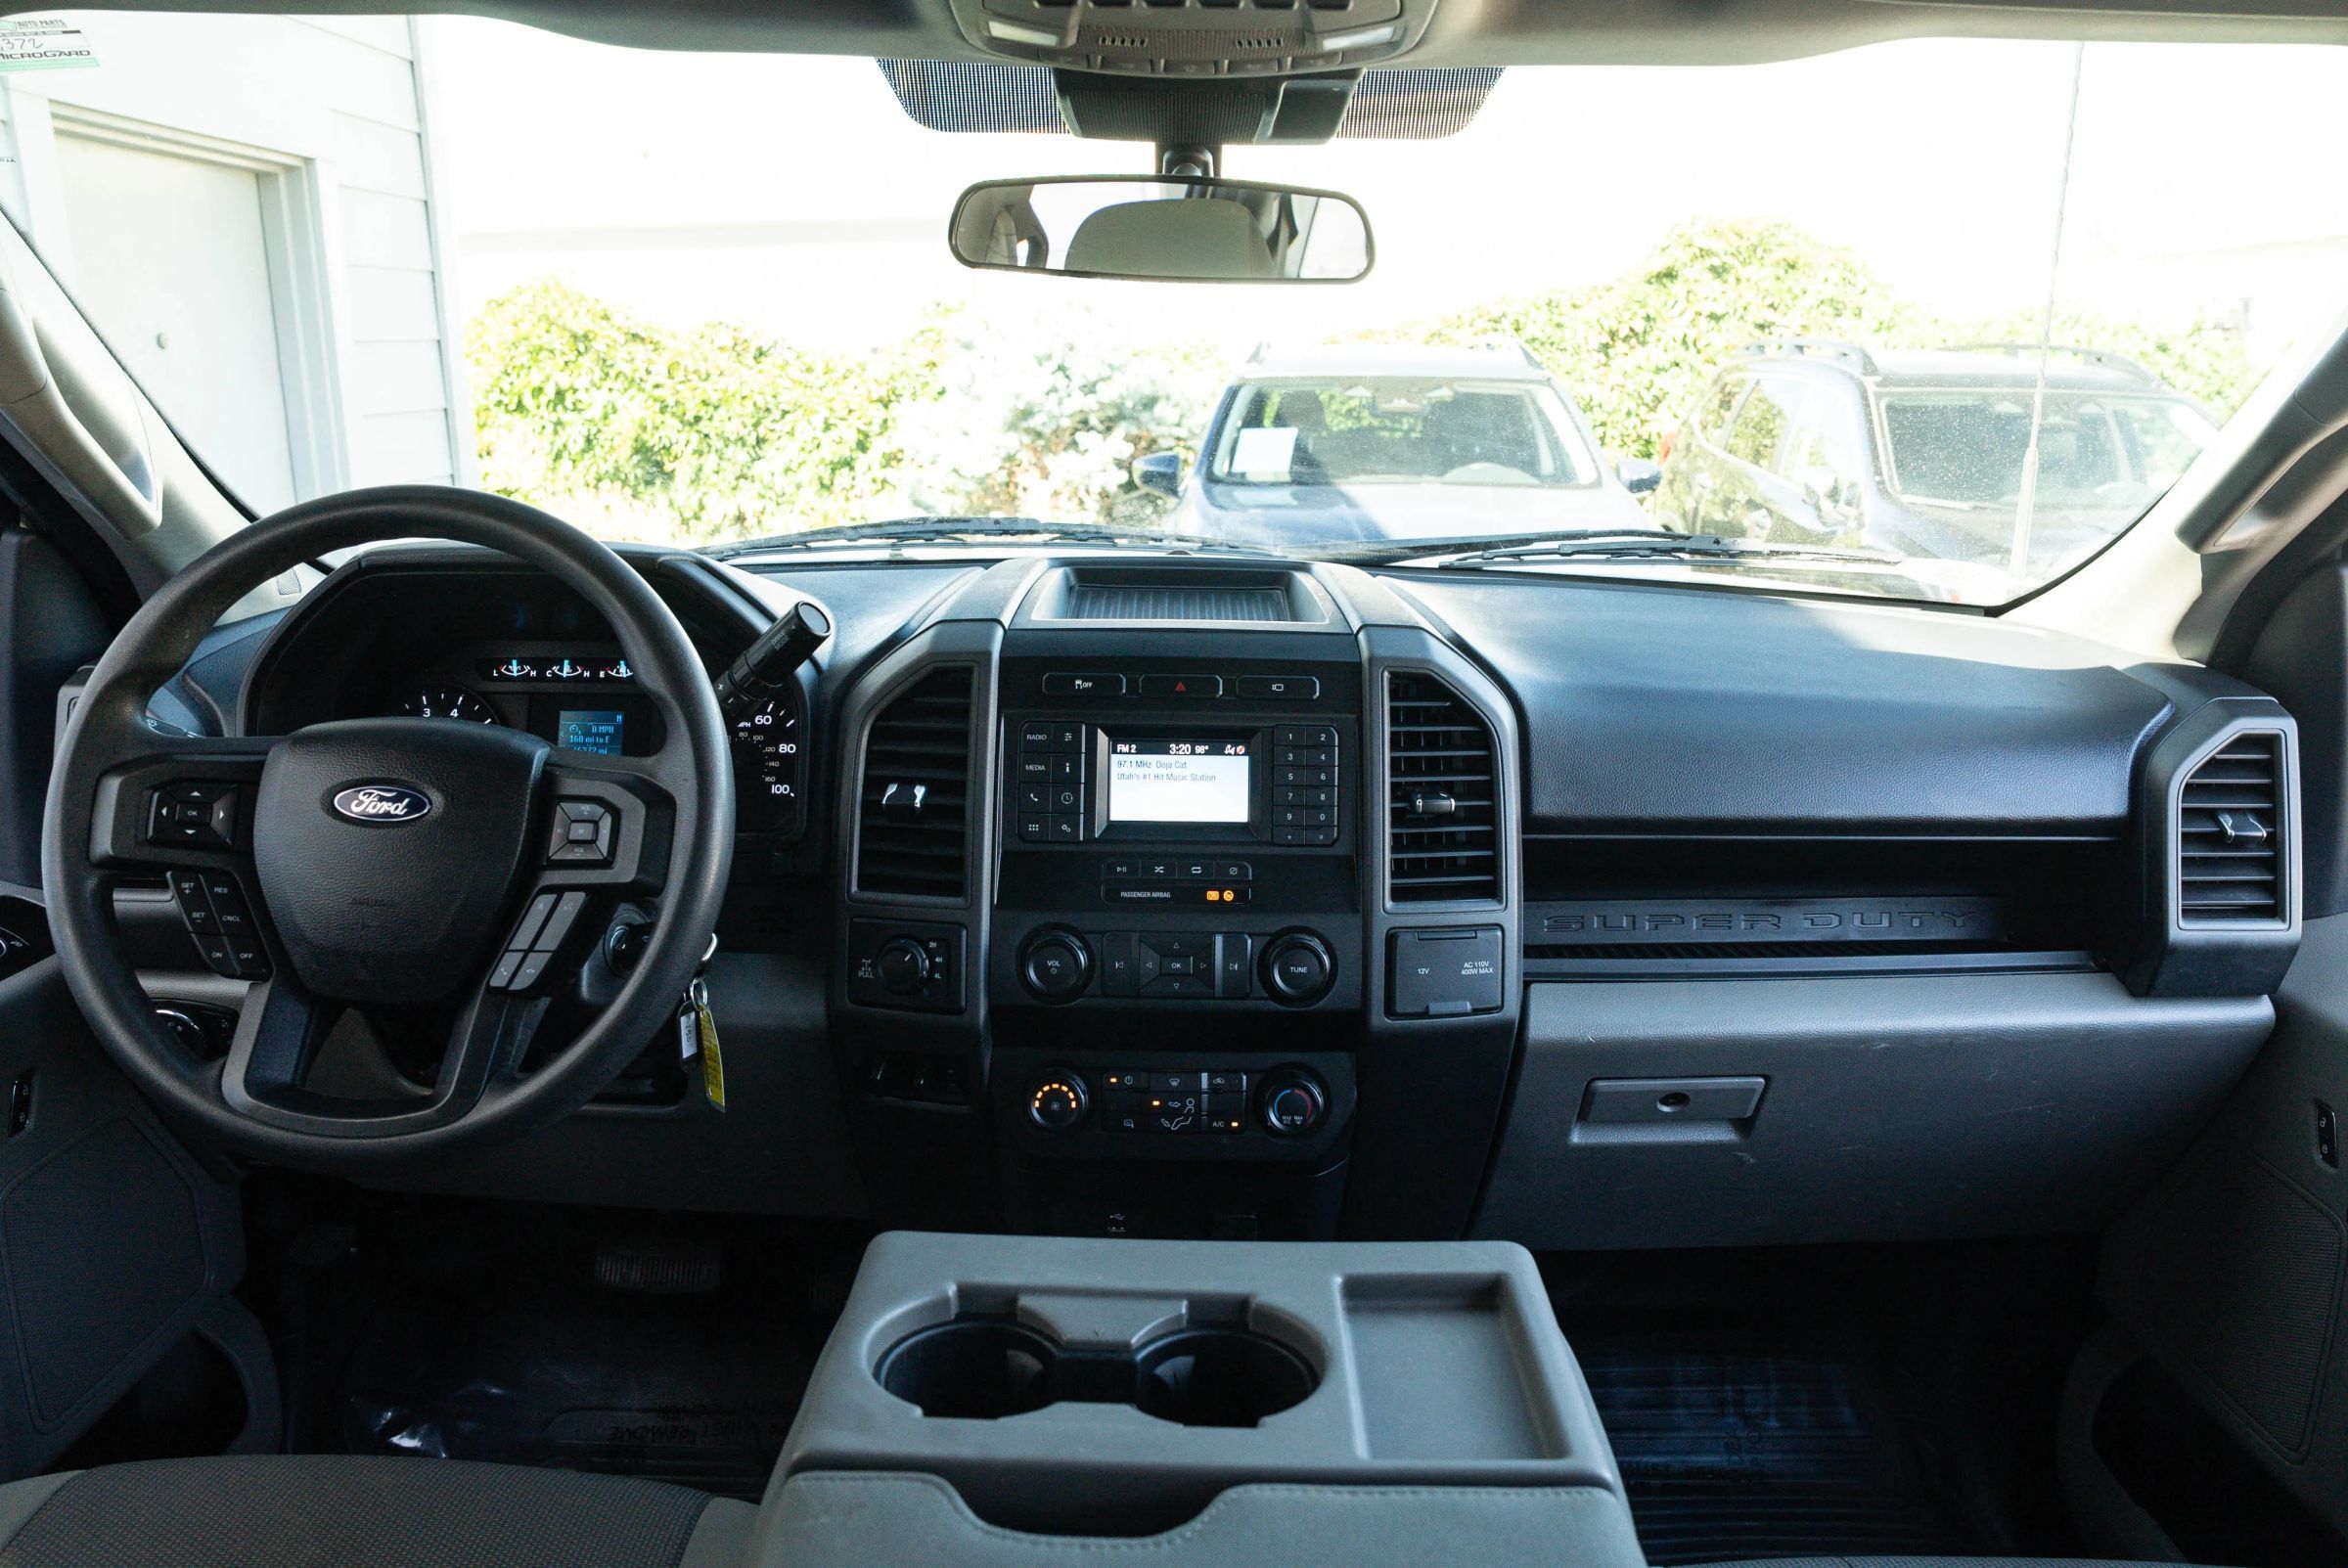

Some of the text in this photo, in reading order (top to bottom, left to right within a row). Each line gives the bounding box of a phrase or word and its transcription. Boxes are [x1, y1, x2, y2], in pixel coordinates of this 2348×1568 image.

[422, 708, 430, 718] 3
[450, 708, 459, 718] 4
[754, 715, 772, 725] 60
[599, 725, 614, 734] MPH
[585, 735, 595, 743] mi
[779, 743, 796, 754] 80
[1116, 744, 1129, 753] FM
[1130, 744, 1137, 753] 2
[1169, 743, 1192, 755] 3:20
[1116, 760, 1133, 769] 97.1
[1135, 760, 1152, 769] MHz
[771, 784, 790, 795] 100
[350, 788, 412, 816] Ford
[1543, 910, 1978, 933] SUPER DUTY
